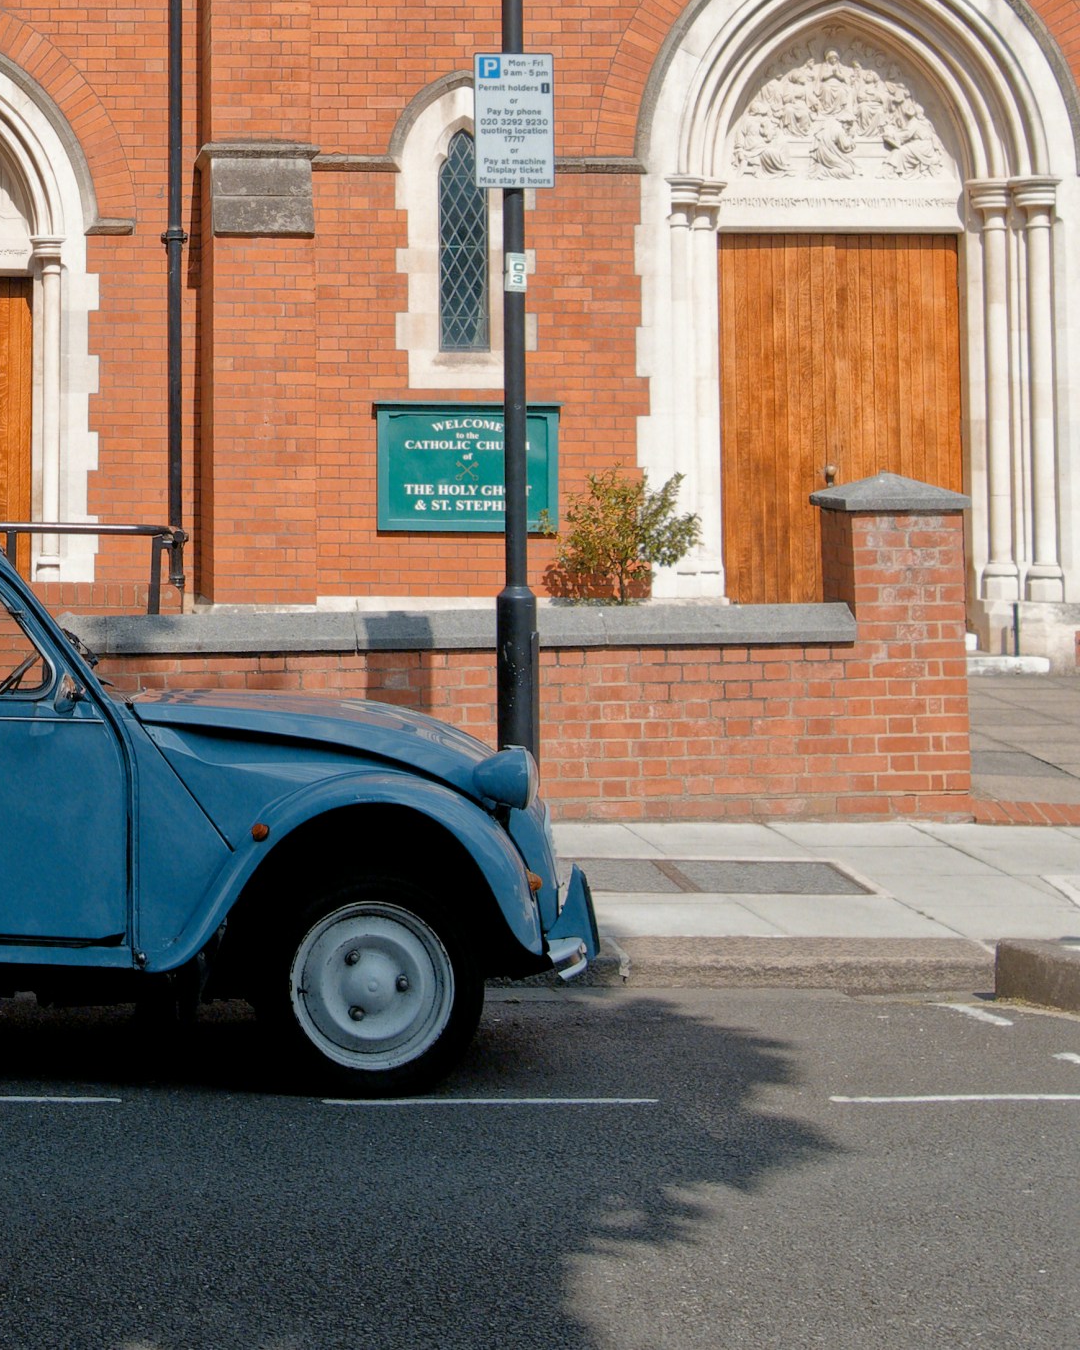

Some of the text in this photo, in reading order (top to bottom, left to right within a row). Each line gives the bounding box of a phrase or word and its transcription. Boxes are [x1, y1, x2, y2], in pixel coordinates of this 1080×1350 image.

[483, 58, 498, 77] P
[508, 59, 526, 67] Mon
[533, 59, 544, 67] Fri
[487, 108, 542, 116] Pay by phone
[487, 166, 517, 174] Display
[499, 177, 516, 185] stay
[432, 419, 504, 433] WELCOME
[405, 440, 471, 450] CATHOLIC
[404, 484, 532, 496] THE HOLY GHT
[415, 500, 427, 510] &
[431, 500, 452, 511] ST.
